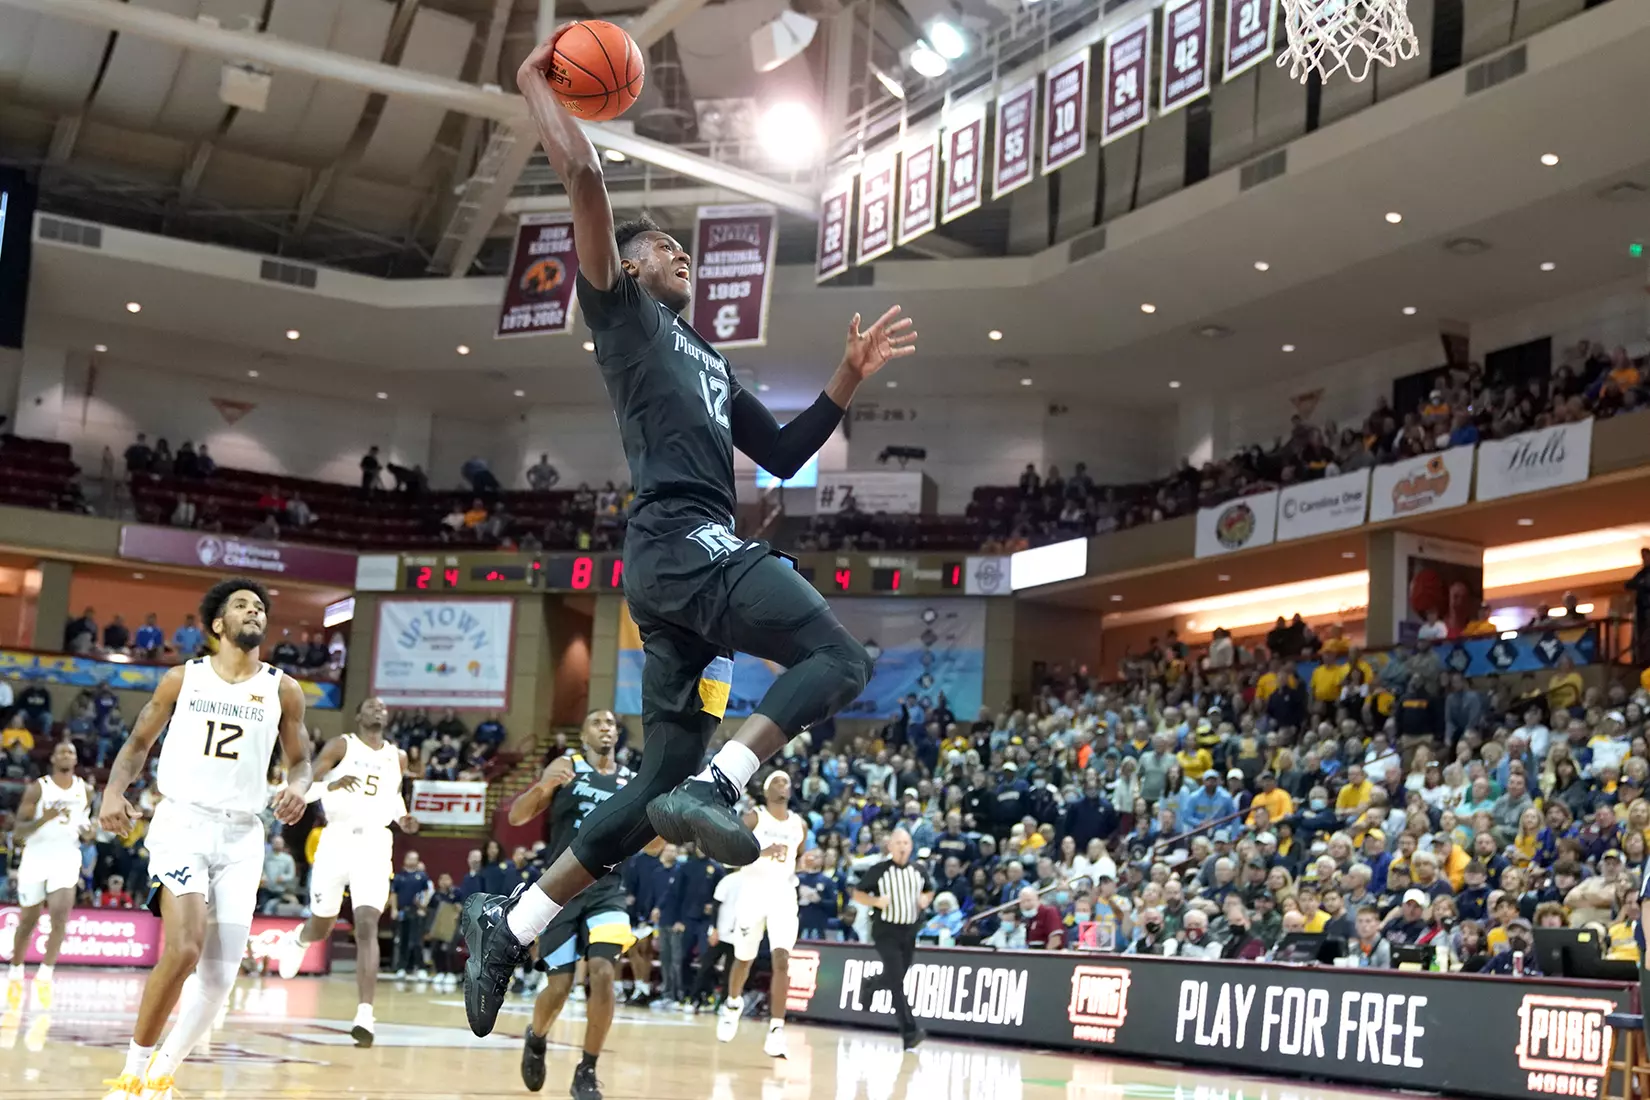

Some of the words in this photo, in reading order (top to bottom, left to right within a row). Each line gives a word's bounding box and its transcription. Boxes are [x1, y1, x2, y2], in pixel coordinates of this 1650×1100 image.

[1239, 0, 1261, 39] 21
[1173, 34, 1199, 73] 42
[1114, 67, 1138, 107] 24
[1054, 100, 1076, 137] 10
[1004, 127, 1025, 162] 55
[698, 262, 764, 278] CHAMPIONS
[699, 370, 729, 428] 12
[416, 566, 432, 589] 2
[444, 568, 459, 587] 4
[571, 557, 593, 590] 8
[835, 569, 850, 590] 4
[892, 570, 900, 590] 1
[952, 565, 960, 585] 1
[397, 606, 489, 651] UPTOWN
[189, 699, 265, 722] MOUNTAINEERS
[204, 720, 244, 760] 12
[364, 774, 380, 796] 5
[415, 793, 482, 812] ESPN
[1077, 975, 1122, 1016] PUBG
[1175, 980, 1256, 1049] PLAY
[1261, 985, 1329, 1058] FOR
[1337, 991, 1428, 1068] FREE
[1530, 1007, 1601, 1062] PUBG
[1527, 1071, 1598, 1098] MOBILE
